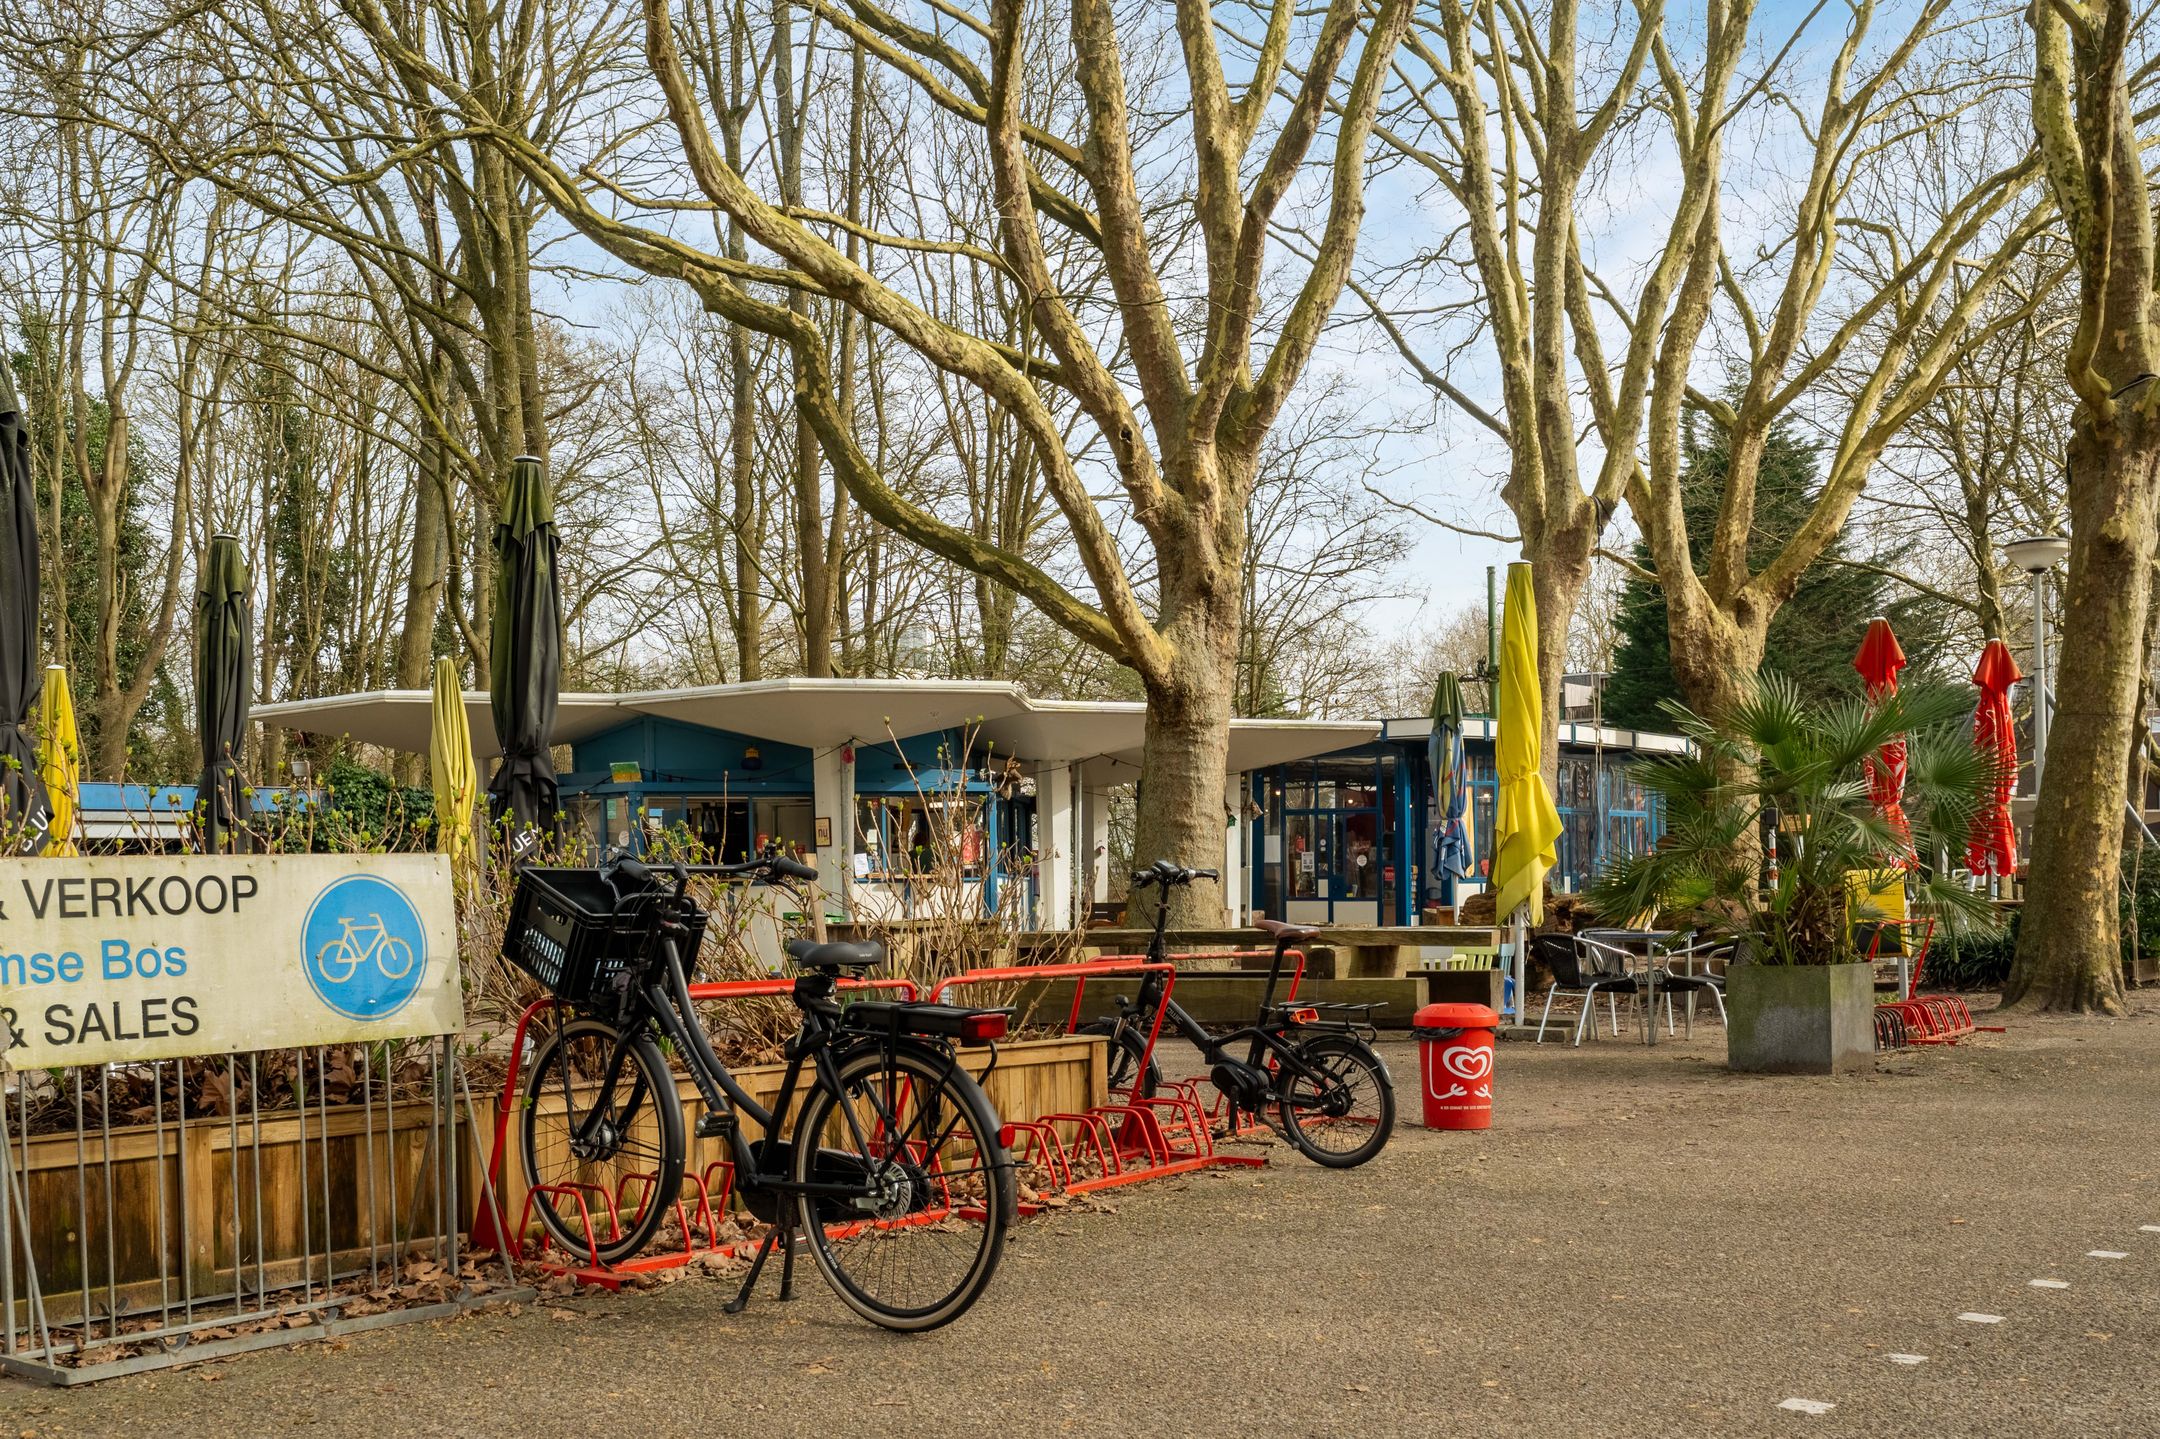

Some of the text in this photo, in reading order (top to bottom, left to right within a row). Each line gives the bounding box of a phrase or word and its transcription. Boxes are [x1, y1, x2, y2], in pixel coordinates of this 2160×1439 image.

[22, 875, 259, 919] VERKOOP
[101, 939, 188, 980] Bos
[44, 996, 200, 1046] SALES
